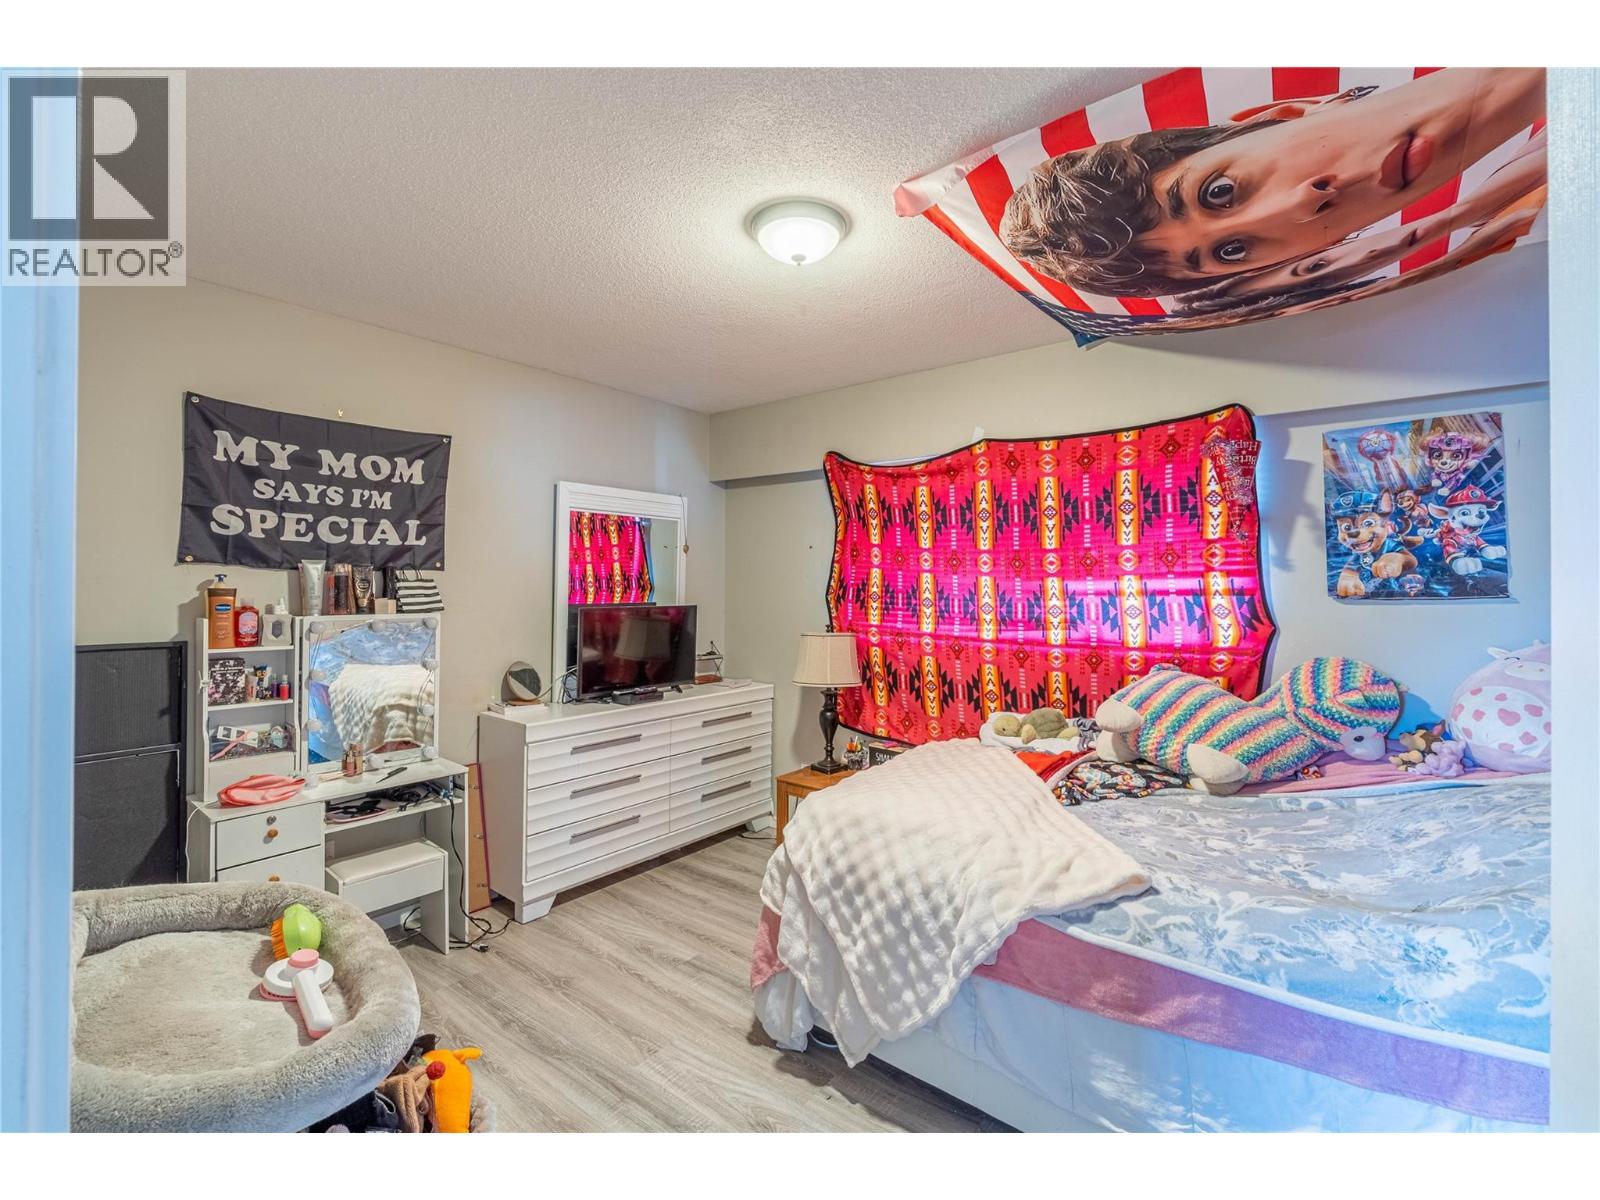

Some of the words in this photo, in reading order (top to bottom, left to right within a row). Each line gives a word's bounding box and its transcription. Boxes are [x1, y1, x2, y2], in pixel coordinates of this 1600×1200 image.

[213, 430, 300, 470] MY
[318, 449, 425, 485] MOM
[252, 478, 344, 506] SAYS
[350, 488, 392, 510] I'M
[210, 504, 427, 546] SPECIAL
